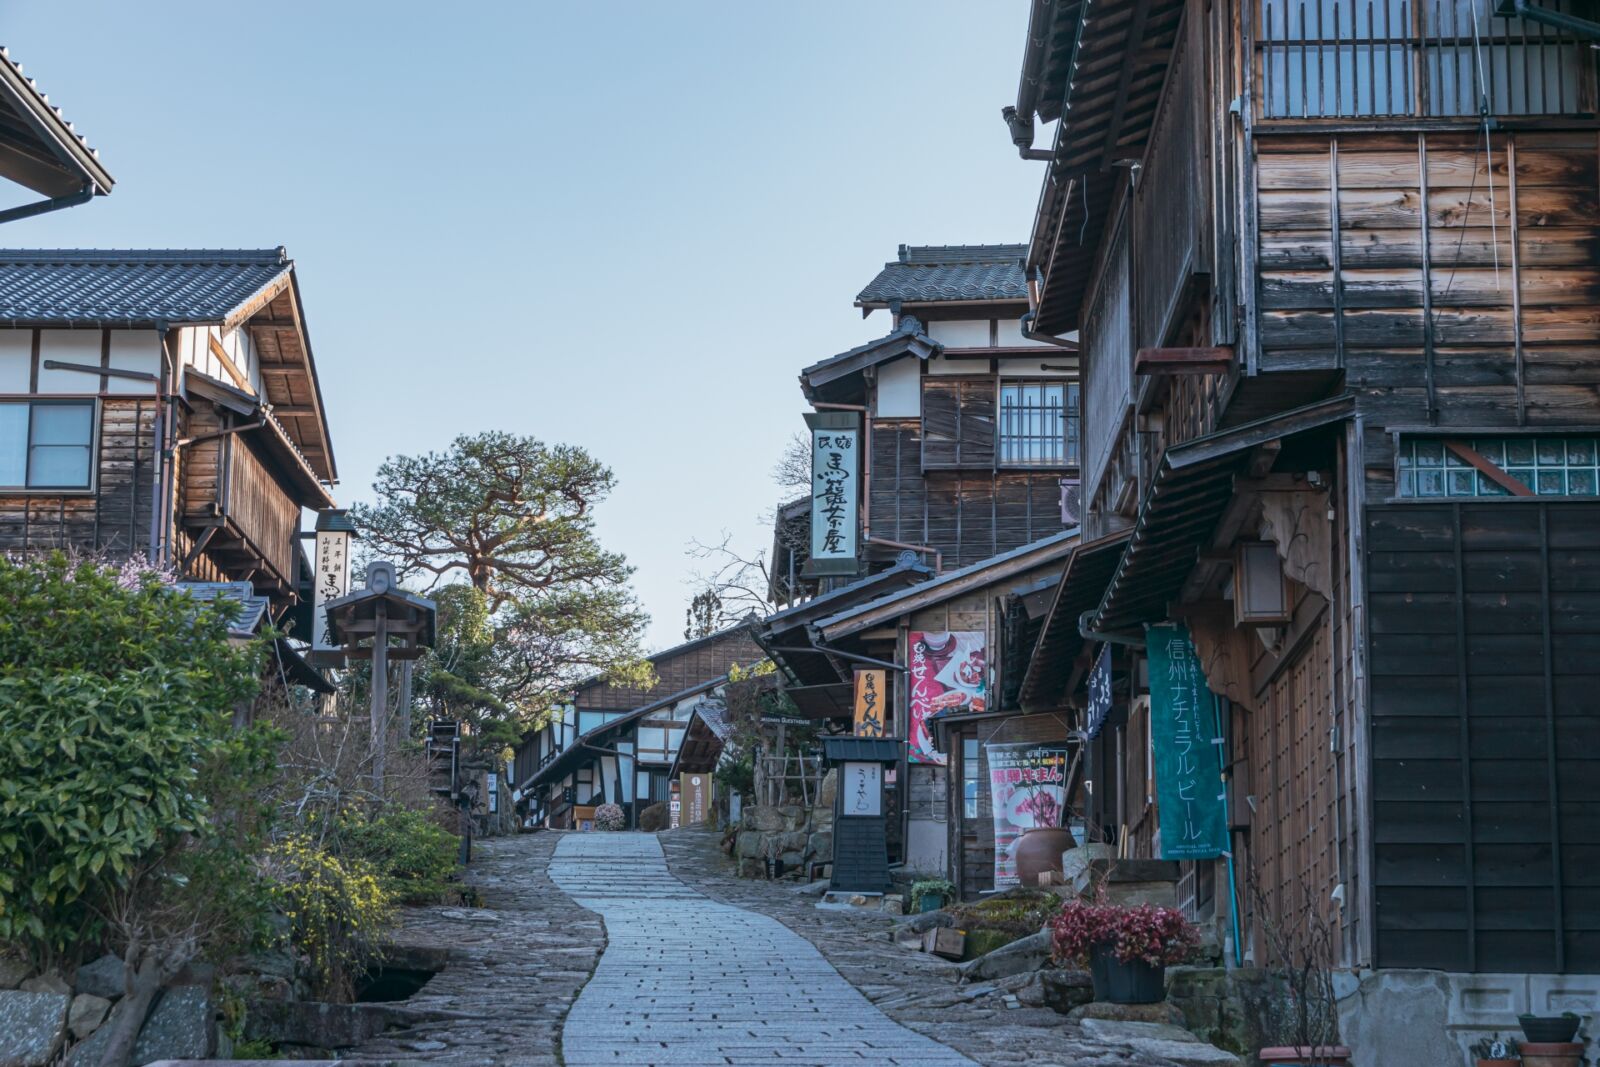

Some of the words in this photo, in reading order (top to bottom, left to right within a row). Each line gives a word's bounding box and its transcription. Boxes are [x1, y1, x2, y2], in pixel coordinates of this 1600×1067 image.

[817, 435, 853, 450] 民宿
[815, 452, 850, 554] 馬籠茶屋
[333, 537, 343, 573] 五平餅
[319, 573, 341, 646] 馬屋
[1165, 638, 1203, 841] 信州ナチュラルビール
[991, 766, 1064, 785] 飛騨牛まん
